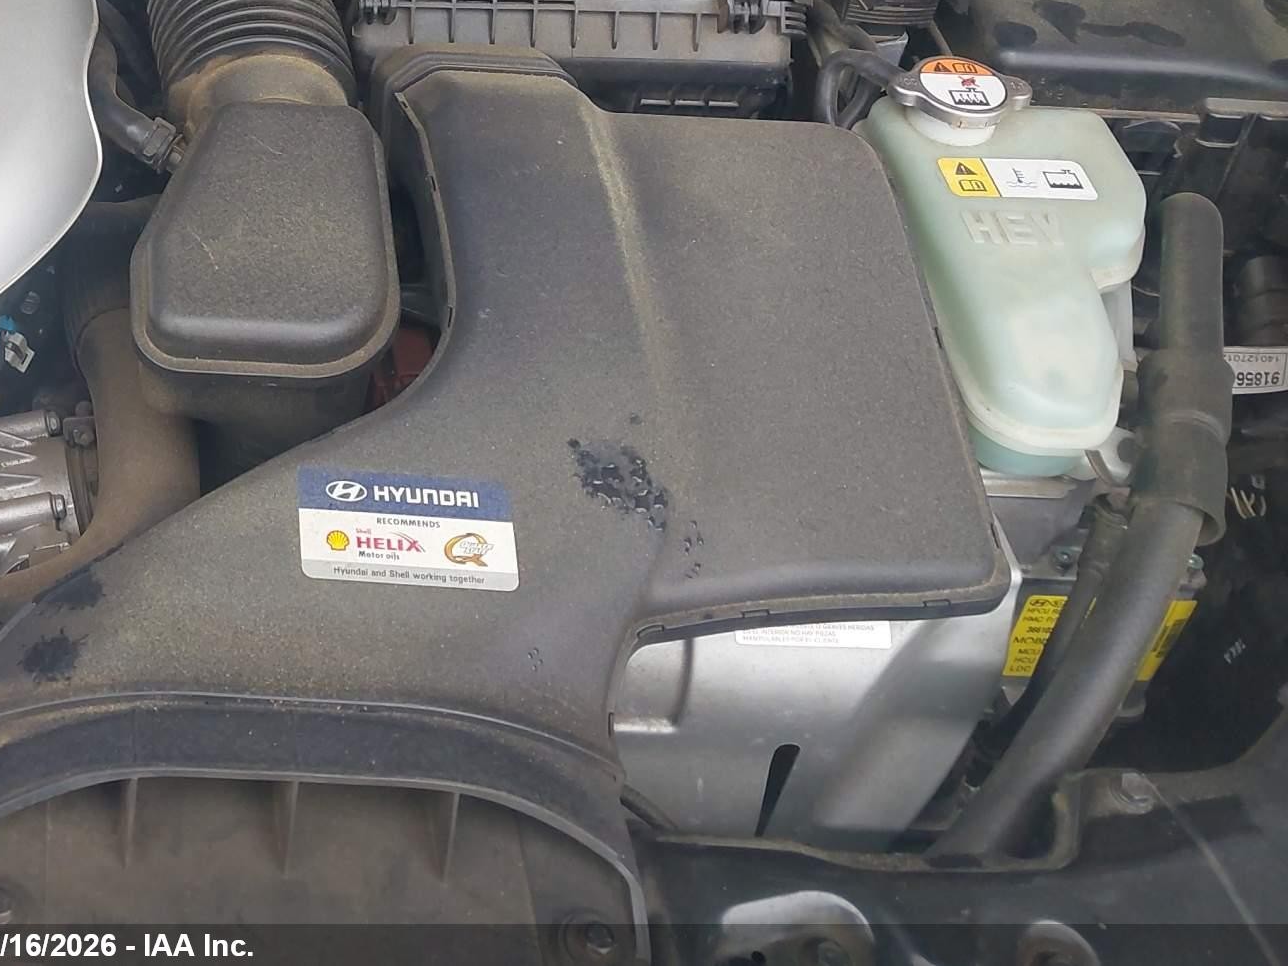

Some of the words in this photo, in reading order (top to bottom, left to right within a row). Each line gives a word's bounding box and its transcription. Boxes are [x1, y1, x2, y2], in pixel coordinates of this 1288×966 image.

[373, 484, 480, 509] HYUNDAI
[376, 517, 441, 529] RECOMMENDS
[356, 536, 423, 553] HELIX
[358, 551, 384, 560] Motor
[385, 552, 400, 561] oils
[333, 566, 368, 578] Hyundai
[371, 568, 386, 578] and
[389, 569, 410, 579] Shell
[413, 570, 447, 583] working
[449, 573, 485, 585] together
